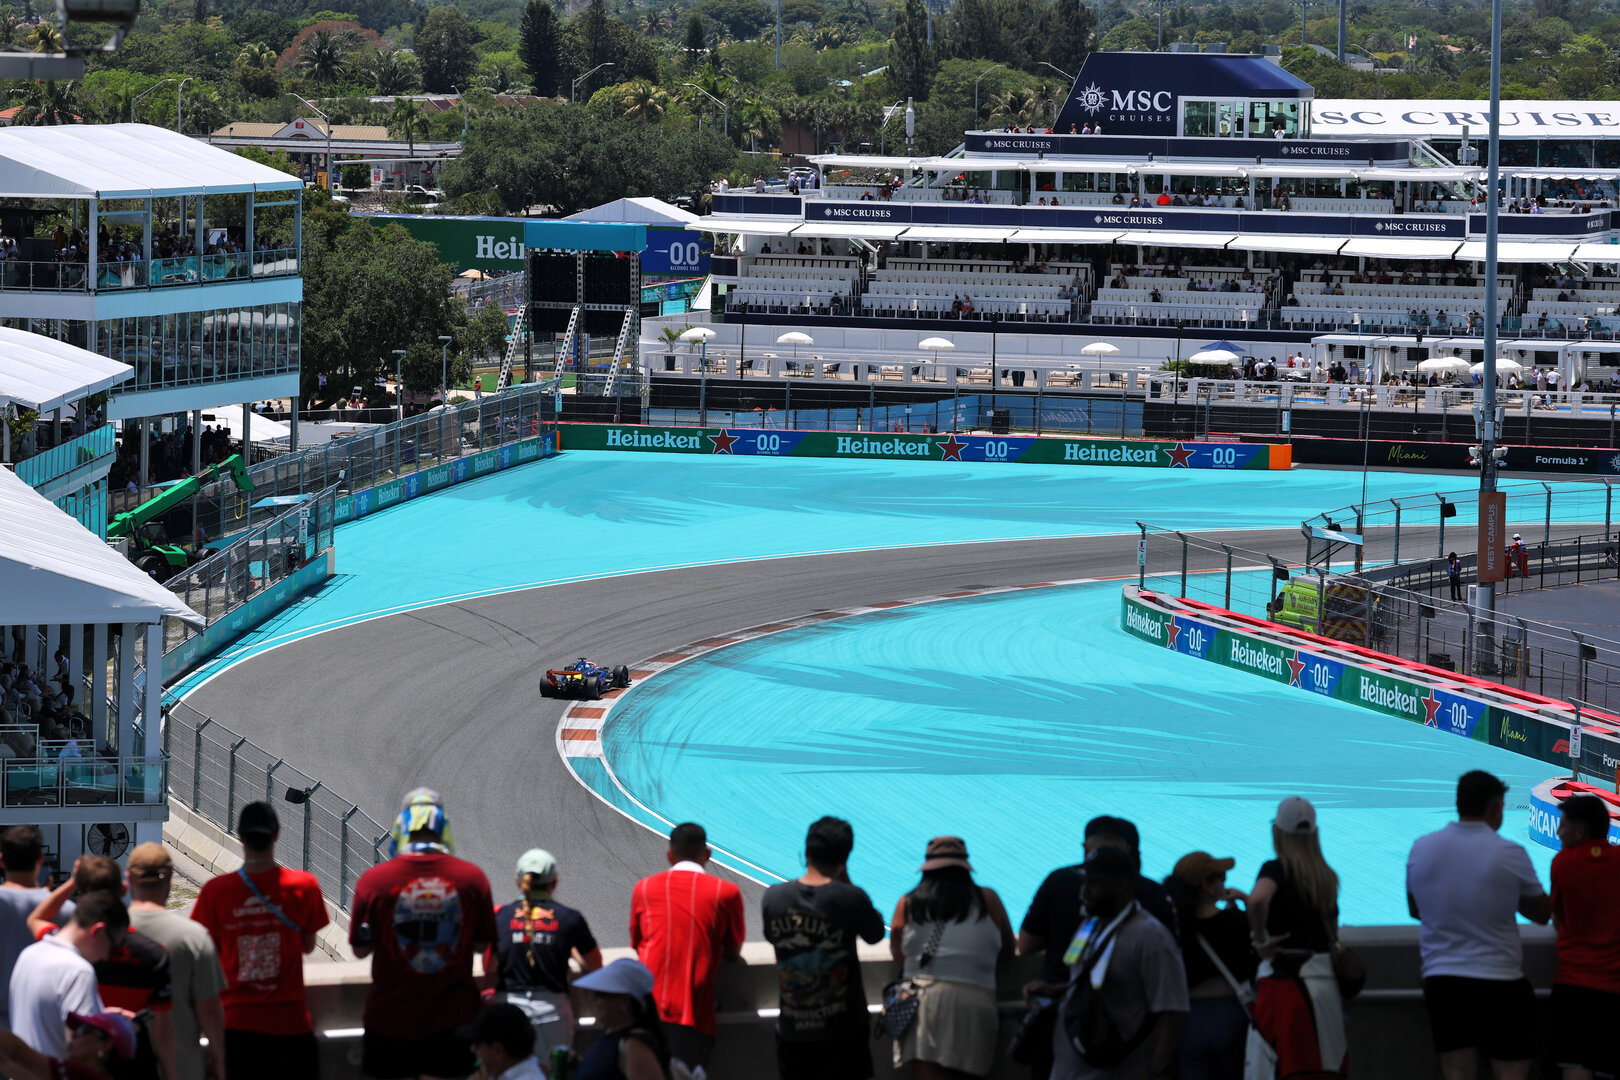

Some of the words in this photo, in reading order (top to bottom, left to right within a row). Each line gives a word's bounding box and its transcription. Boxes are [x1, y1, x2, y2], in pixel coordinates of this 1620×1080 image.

[1110, 89, 1172, 112] MSC
[1109, 114, 1171, 122] CRUISES
[993, 140, 1012, 148] MSC
[1012, 140, 1051, 149] CRUISES
[1290, 147, 1309, 155] MSC
[1310, 147, 1350, 156] CRUISES
[833, 208, 852, 216] MSC
[852, 209, 891, 218] CRUISES
[1103, 215, 1122, 224] MSC
[1123, 215, 1163, 225] CRUISES
[1384, 222, 1404, 231] MSC
[1405, 223, 1446, 232] CRUISES
[670, 241, 700, 266] 0.0
[606, 429, 701, 449] Heineken
[757, 434, 780, 451] 0.0
[836, 436, 930, 456] Heineken
[985, 440, 1008, 458] 0.0
[1063, 443, 1158, 463] Heineken
[1212, 447, 1236, 465] 0.0
[1387, 444, 1429, 464] Miami
[1535, 455, 1577, 465] Formula
[1487, 504, 1496, 544] CAMPUS
[1487, 545, 1495, 571] WEST
[1126, 603, 1162, 641] Heineken
[1189, 627, 1202, 652] 0.0
[1230, 638, 1284, 676] Heineken
[1314, 663, 1329, 689] 0.0
[1359, 675, 1419, 715] Heineken
[1451, 702, 1467, 729] 0.0
[1500, 716, 1528, 745] Miami
[771, 914, 844, 943] SUZUKA
